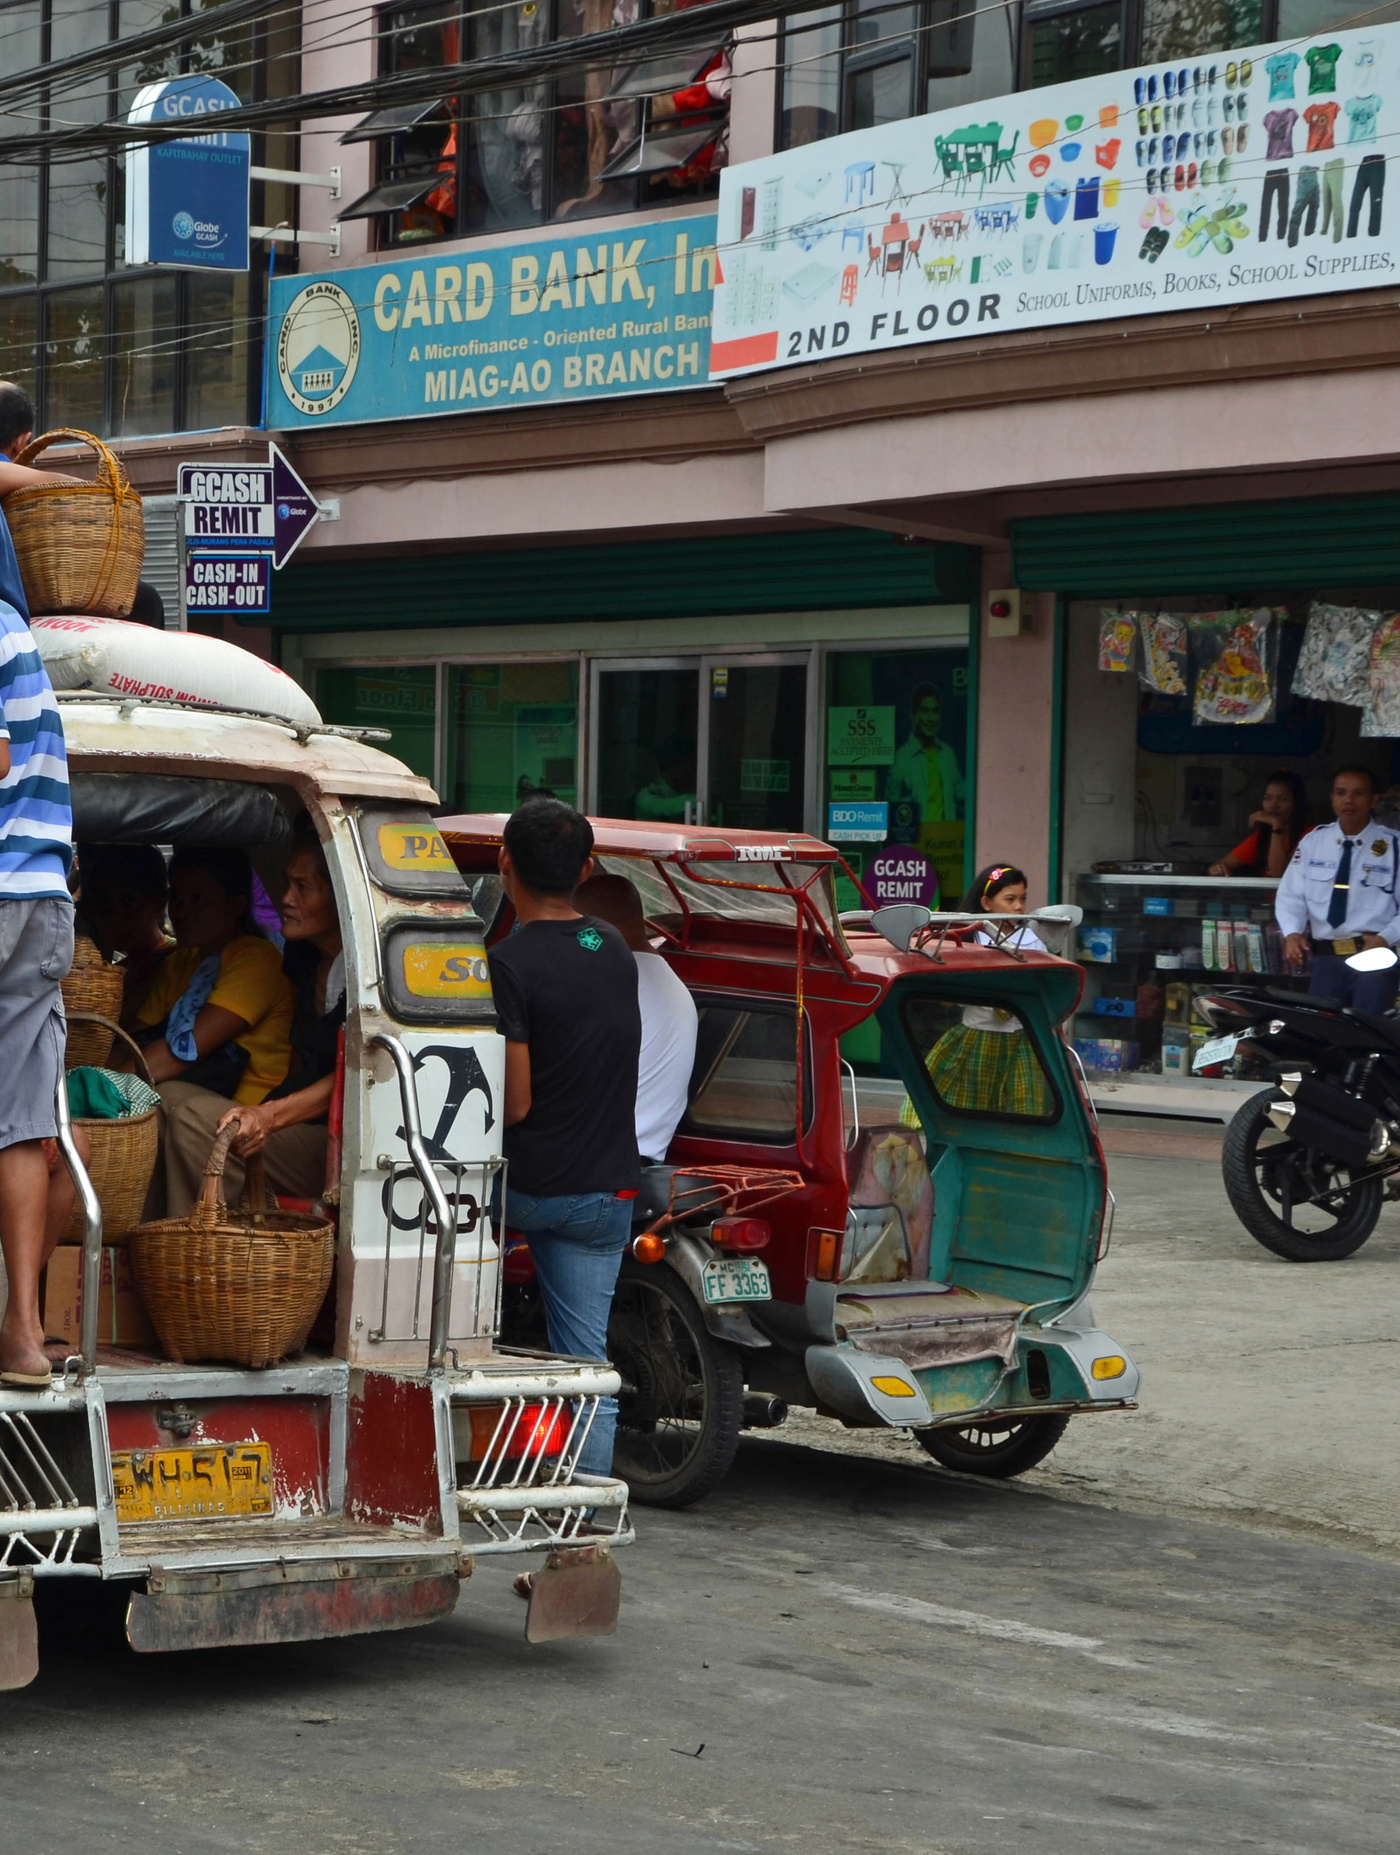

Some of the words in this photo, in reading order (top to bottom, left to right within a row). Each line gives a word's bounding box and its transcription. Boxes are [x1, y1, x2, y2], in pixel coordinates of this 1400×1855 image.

[157, 147, 209, 162] KAPITBAHAY
[210, 151, 242, 164] OUTLET
[194, 221, 219, 233] Globe
[195, 232, 218, 242] GCASH
[304, 285, 342, 301] BANK
[373, 261, 493, 332] CARD
[511, 237, 656, 317] BANK,
[787, 320, 850, 358] 2ND
[870, 293, 1001, 341] FLOOR
[279, 315, 292, 375] CARD
[350, 318, 359, 361] INC.
[408, 346, 420, 362] A
[424, 333, 528, 361] Microfinance
[543, 324, 617, 348] Oriented
[622, 319, 669, 338] Rural
[423, 358, 552, 403] MIAG-AO
[563, 341, 699, 389] BRANCH
[300, 396, 335, 413] 1997
[190, 472, 265, 503] GCASH
[193, 505, 262, 535] REMIT
[193, 562, 259, 584] CASH-IN
[186, 585, 265, 606] CASH-OUT
[107, 672, 174, 699] SULPHATE
[848, 719, 876, 737] SSS
[832, 810, 857, 823] BDO
[857, 811, 883, 823] Remit
[874, 859, 927, 877] GCASH
[877, 881, 924, 899] REMIT
[706, 1274, 726, 1298] FF
[732, 1272, 769, 1296] 3363
[232, 1467, 251, 1475] 2011
